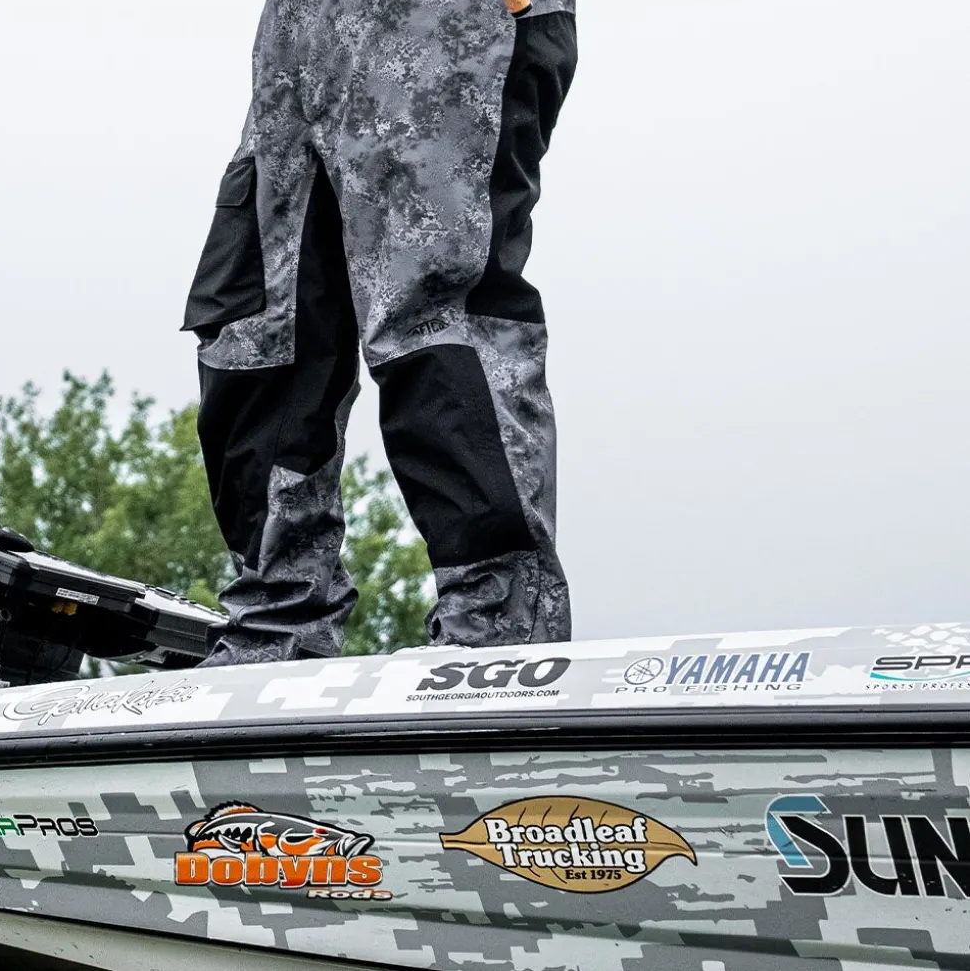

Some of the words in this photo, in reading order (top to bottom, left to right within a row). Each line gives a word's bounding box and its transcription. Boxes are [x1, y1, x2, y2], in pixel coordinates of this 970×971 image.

[415, 656, 572, 691] SGO
[664, 652, 811, 685] YAMAHA
[406, 689, 560, 702] SOUTHGEORGIAOUTDOORS.COM
[615, 685, 668, 694] PRO
[684, 683, 802, 693] FISHING
[483, 816, 650, 844] Broadleaf
[174, 851, 384, 890] Dobyns
[495, 842, 648, 874] Trucking
[565, 869, 589, 880] Est
[590, 869, 622, 881] 1975
[306, 888, 394, 902] Rods
